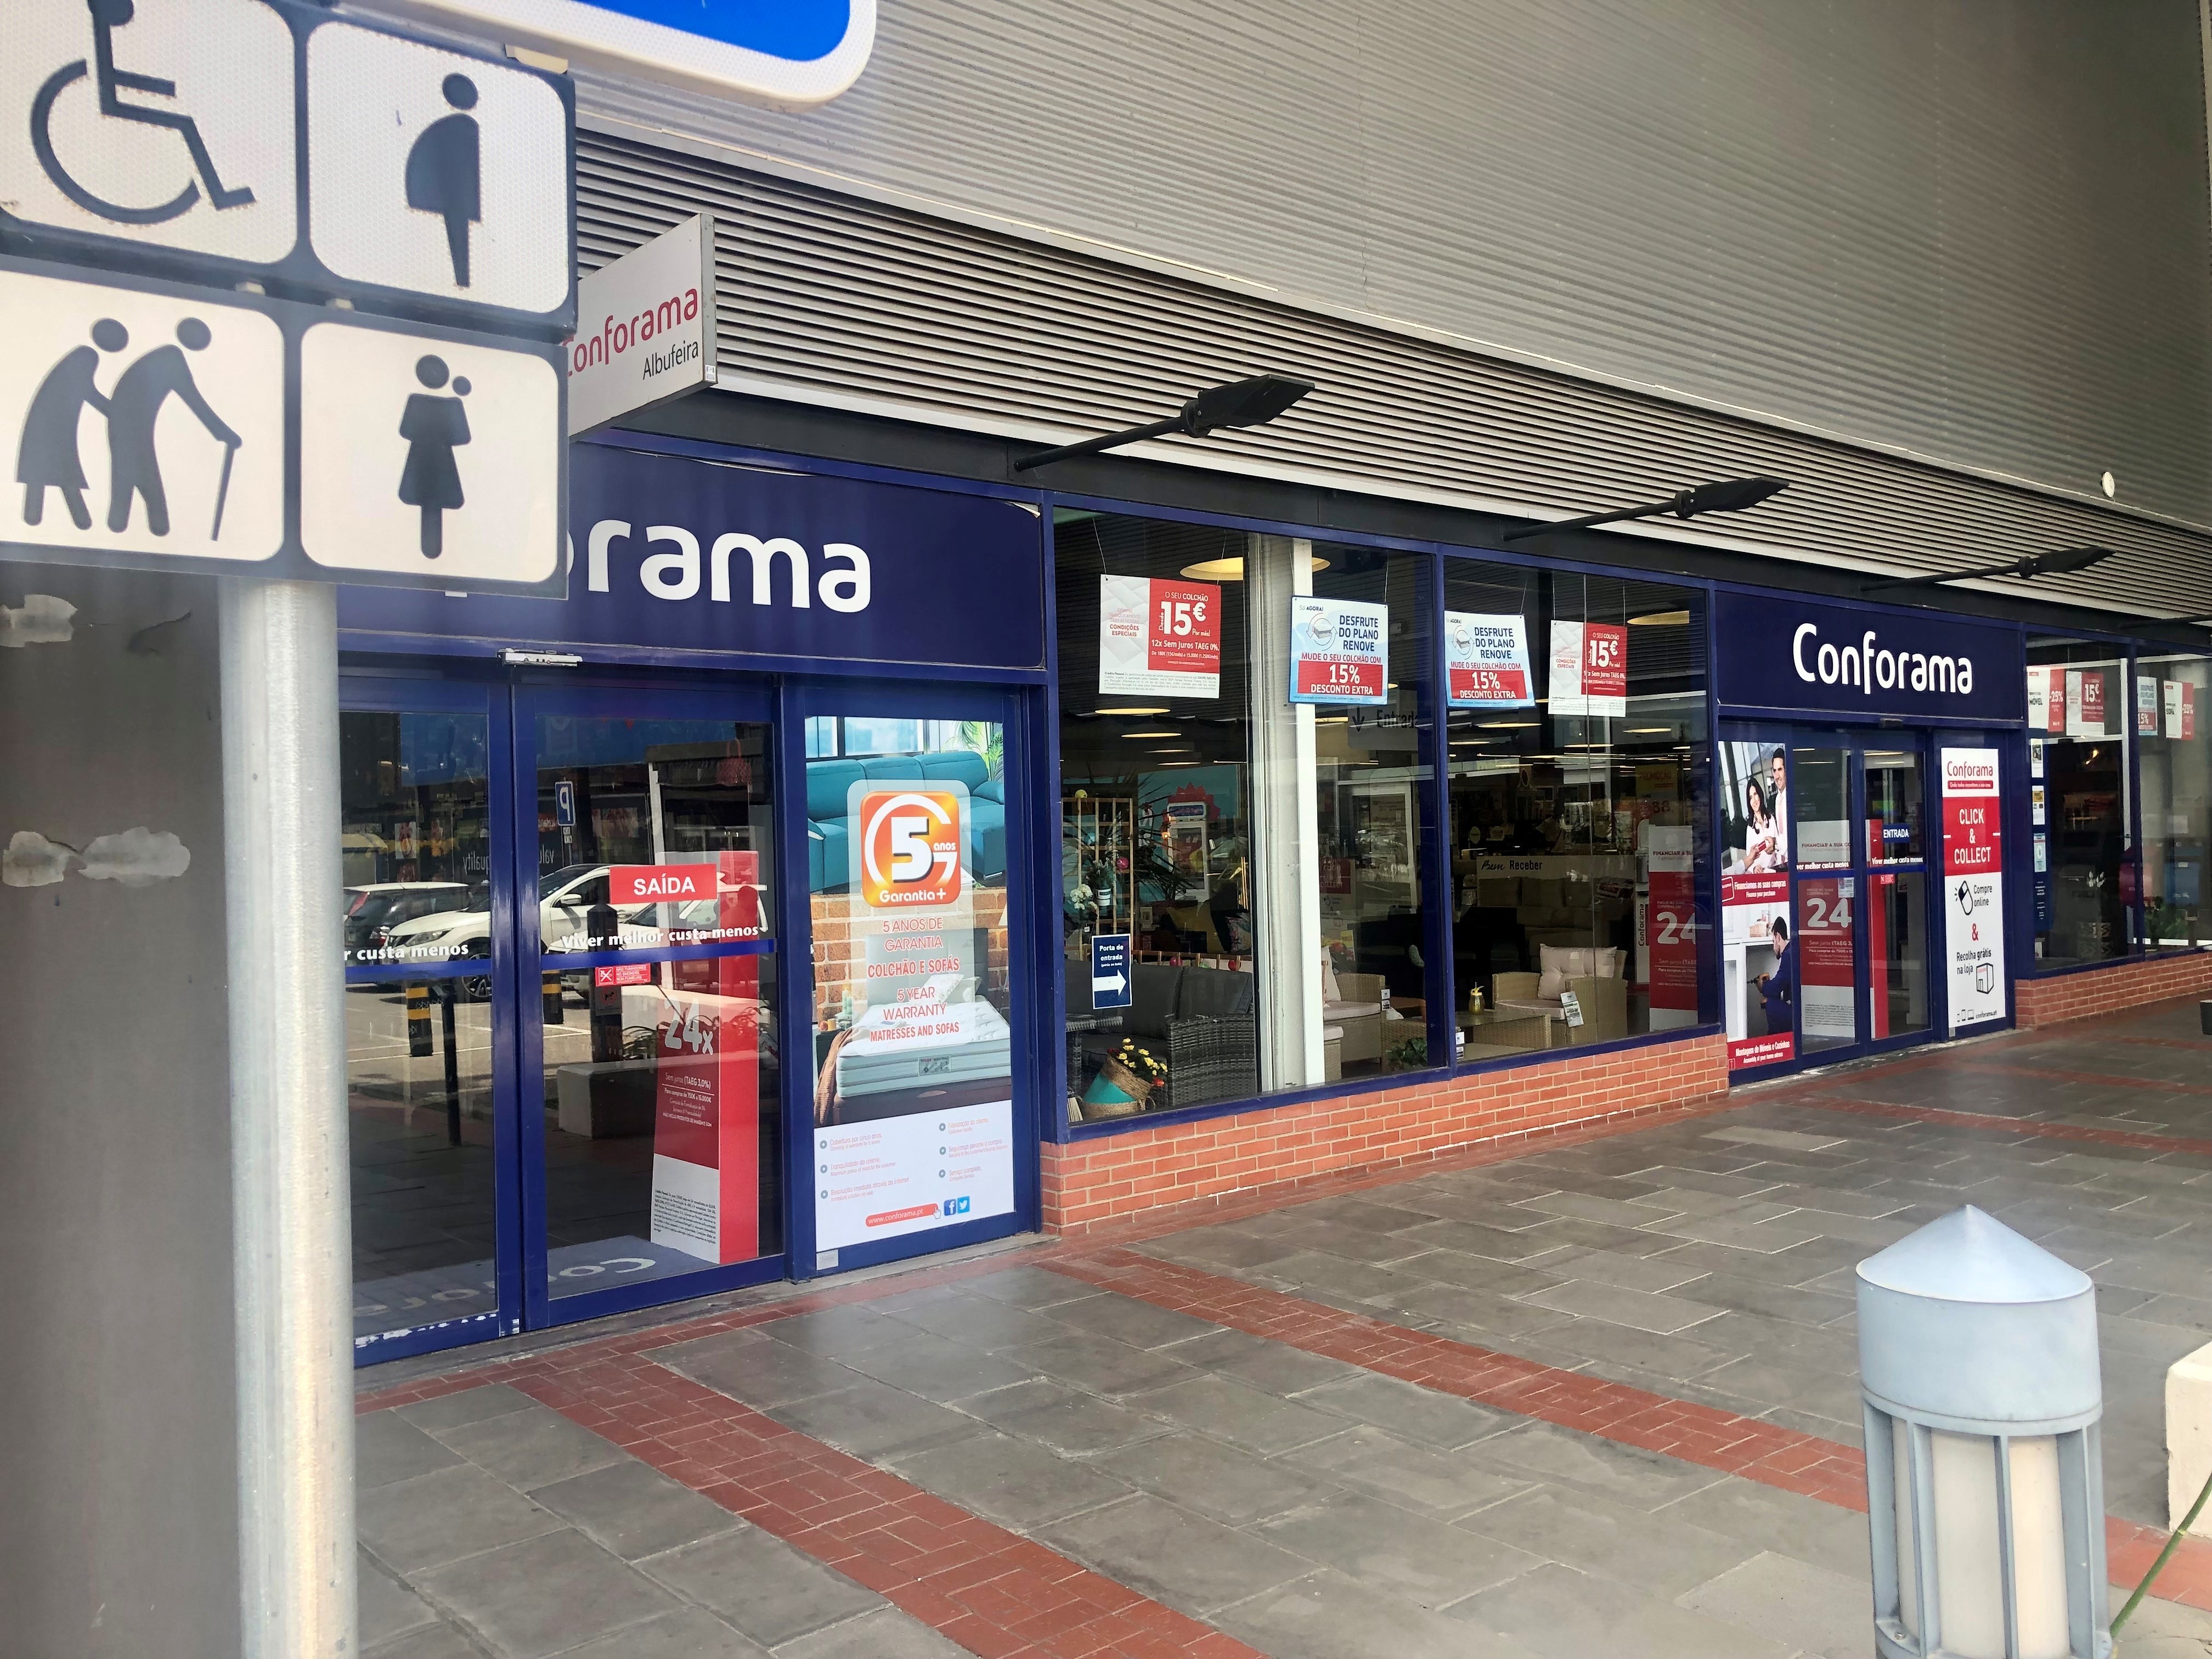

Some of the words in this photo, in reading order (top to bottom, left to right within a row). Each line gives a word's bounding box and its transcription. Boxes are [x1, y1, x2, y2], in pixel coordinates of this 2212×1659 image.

[562, 288, 698, 377] onforama
[643, 338, 699, 380] Albufeira
[567, 519, 871, 613] rama
[1161, 601, 1206, 636] 15€
[1340, 615, 1378, 628] DESFRUTE
[1339, 628, 1350, 637] DO
[1353, 629, 1378, 640] PLANO
[1475, 627, 1513, 636] DESFRUTE
[1177, 641, 1194, 650] Juros
[1344, 640, 1374, 651] RENOVE
[1476, 639, 1486, 647] DO
[1488, 639, 1514, 648] PLANO
[1343, 654, 1368, 663] COLCHÃO
[1481, 650, 1511, 658] RENOVE
[1590, 640, 1618, 667] 15€
[1793, 623, 1972, 695] Conforama
[1482, 661, 1506, 669] COLCHÃO
[1329, 664, 1360, 684] 15%
[1471, 672, 1500, 690] 15%
[1311, 684, 1350, 693] DESCONTO
[1352, 686, 1373, 695] EXTRA
[1460, 690, 1492, 698] DESCONTO
[1948, 761, 1993, 777] Conforama
[1960, 808, 1984, 825] CLICK
[1883, 829, 1909, 838] ENTRADA
[1970, 828, 1976, 843] &
[890, 816, 934, 883] 5
[933, 842, 956, 850] anos
[1954, 847, 1991, 864] COLLECT
[1482, 860, 1505, 870] Bem
[1510, 860, 1543, 870] Receber
[634, 873, 696, 895] SAÍDA
[1974, 884, 1992, 896] Compre
[1974, 897, 1989, 906] online
[1807, 898, 1852, 928] 24
[883, 921, 890, 933] 5
[892, 919, 926, 932] ANOS
[929, 917, 943, 930] DE
[1972, 923, 1978, 941] &
[561, 934, 603, 949] Viver
[608, 929, 664, 946] melhor
[669, 928, 707, 941] custa
[712, 926, 759, 938] menos
[885, 936, 943, 951] GARANTIA
[357, 946, 405, 960] custa
[411, 944, 469, 957] menos
[1957, 950, 1976, 962] Recolha
[1977, 947, 1991, 961] grátis
[868, 960, 916, 978] COLCHÃO
[919, 961, 925, 974] E
[928, 955, 960, 973] SOFÁS
[1964, 964, 1973, 975] loja
[897, 989, 905, 1002] 5
[906, 986, 935, 1000] YEAR
[883, 1003, 947, 1020] WARRANTY
[1976, 1009, 1997, 1019] conforama.pt
[664, 995, 713, 1055] 24x
[870, 1026, 916, 1042] MATRESSES
[918, 1024, 933, 1036] AND
[936, 1022, 960, 1035] SOFAS
[685, 1076, 697, 1086] (TAEG
[868, 1209, 923, 1224] www.conforama.pt
